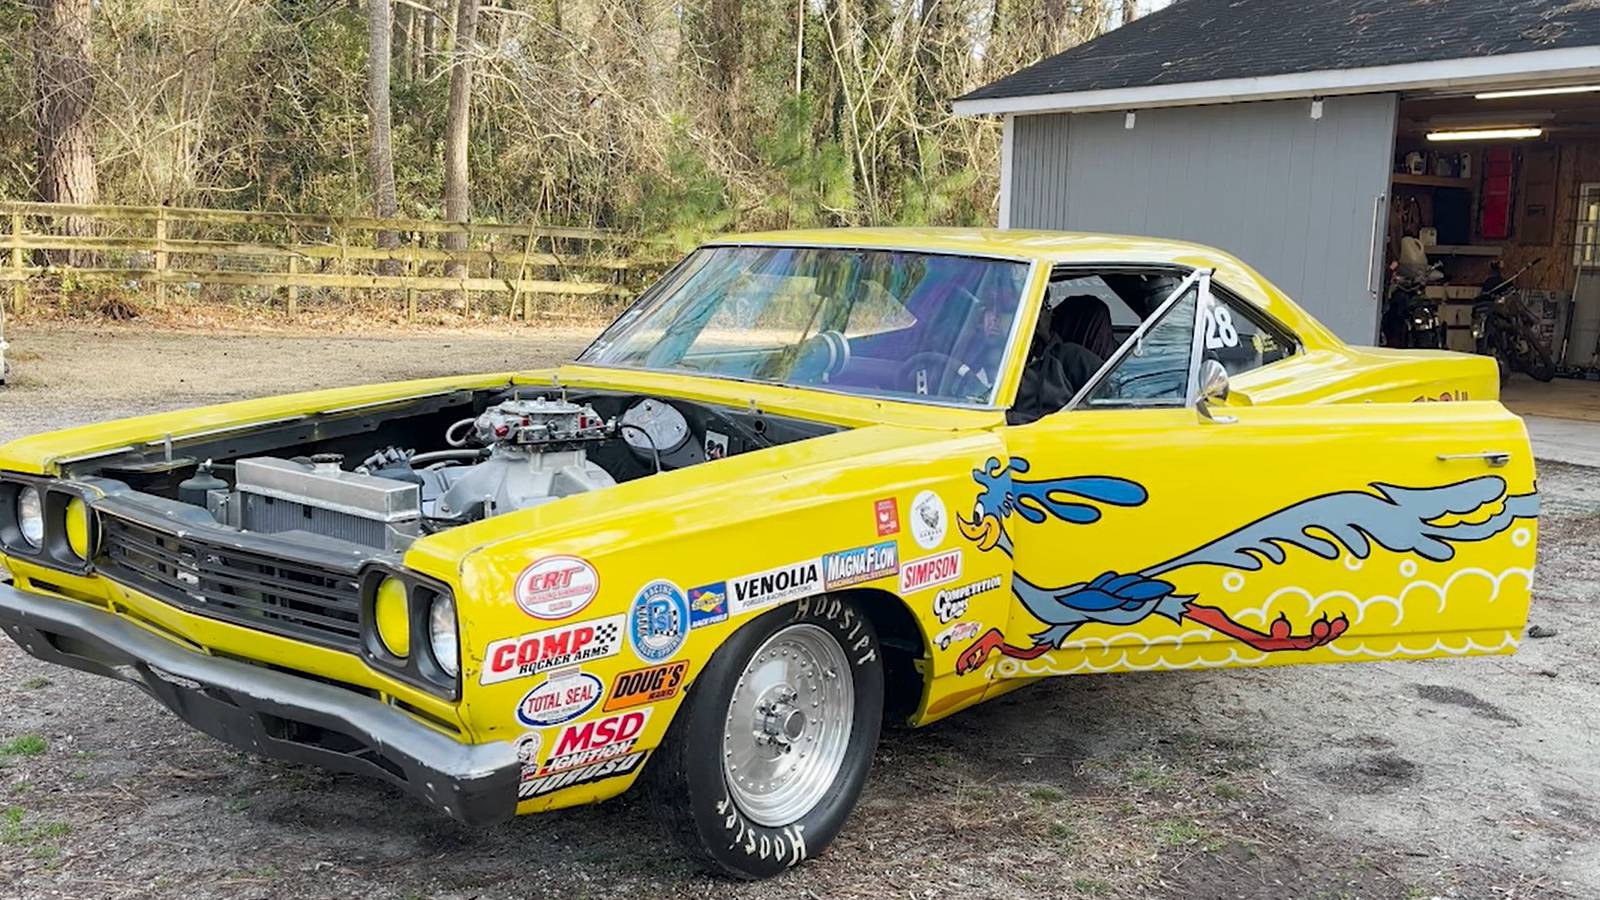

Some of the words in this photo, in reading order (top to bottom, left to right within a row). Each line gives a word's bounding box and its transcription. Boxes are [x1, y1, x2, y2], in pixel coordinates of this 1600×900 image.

[1205, 306, 1238, 349] 28
[527, 566, 585, 594] CRT
[735, 564, 818, 602] VENOLIA
[904, 554, 960, 588] SIMPSON
[491, 627, 595, 672] COMP
[519, 654, 571, 675] ROCKER
[573, 644, 609, 661] ARMS
[528, 692, 562, 713] TOTAL
[565, 685, 594, 706] SEAL
[613, 664, 684, 699] DOUG'S
[555, 711, 645, 755] MSD
